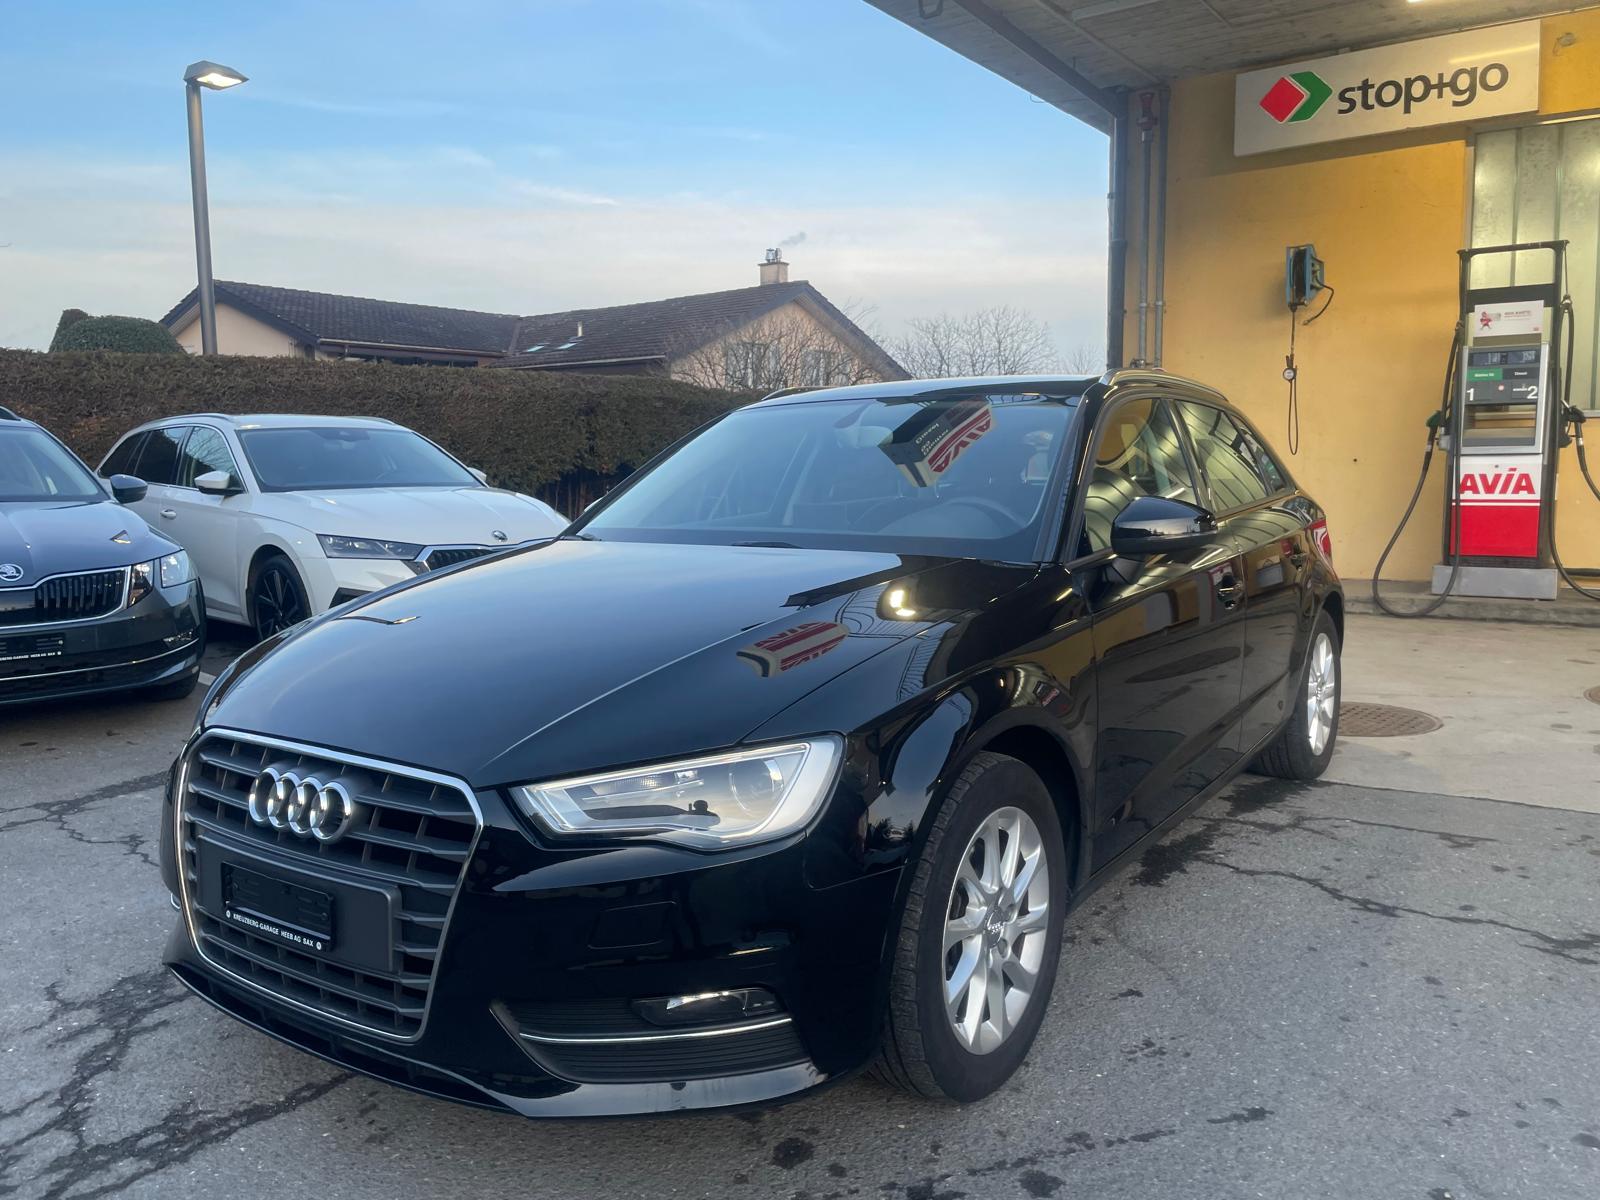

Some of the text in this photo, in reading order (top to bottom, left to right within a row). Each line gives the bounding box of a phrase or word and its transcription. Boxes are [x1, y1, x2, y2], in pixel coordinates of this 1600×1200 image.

[1337, 62, 1509, 114] stop+go
[1466, 388, 1475, 401] 1
[1527, 385, 1538, 399] 2
[1459, 467, 1536, 494] AVIA
[233, 913, 279, 934] KREUZBERG-GARAGE
[293, 935, 302, 943] AG
[302, 937, 314, 947] SAX
